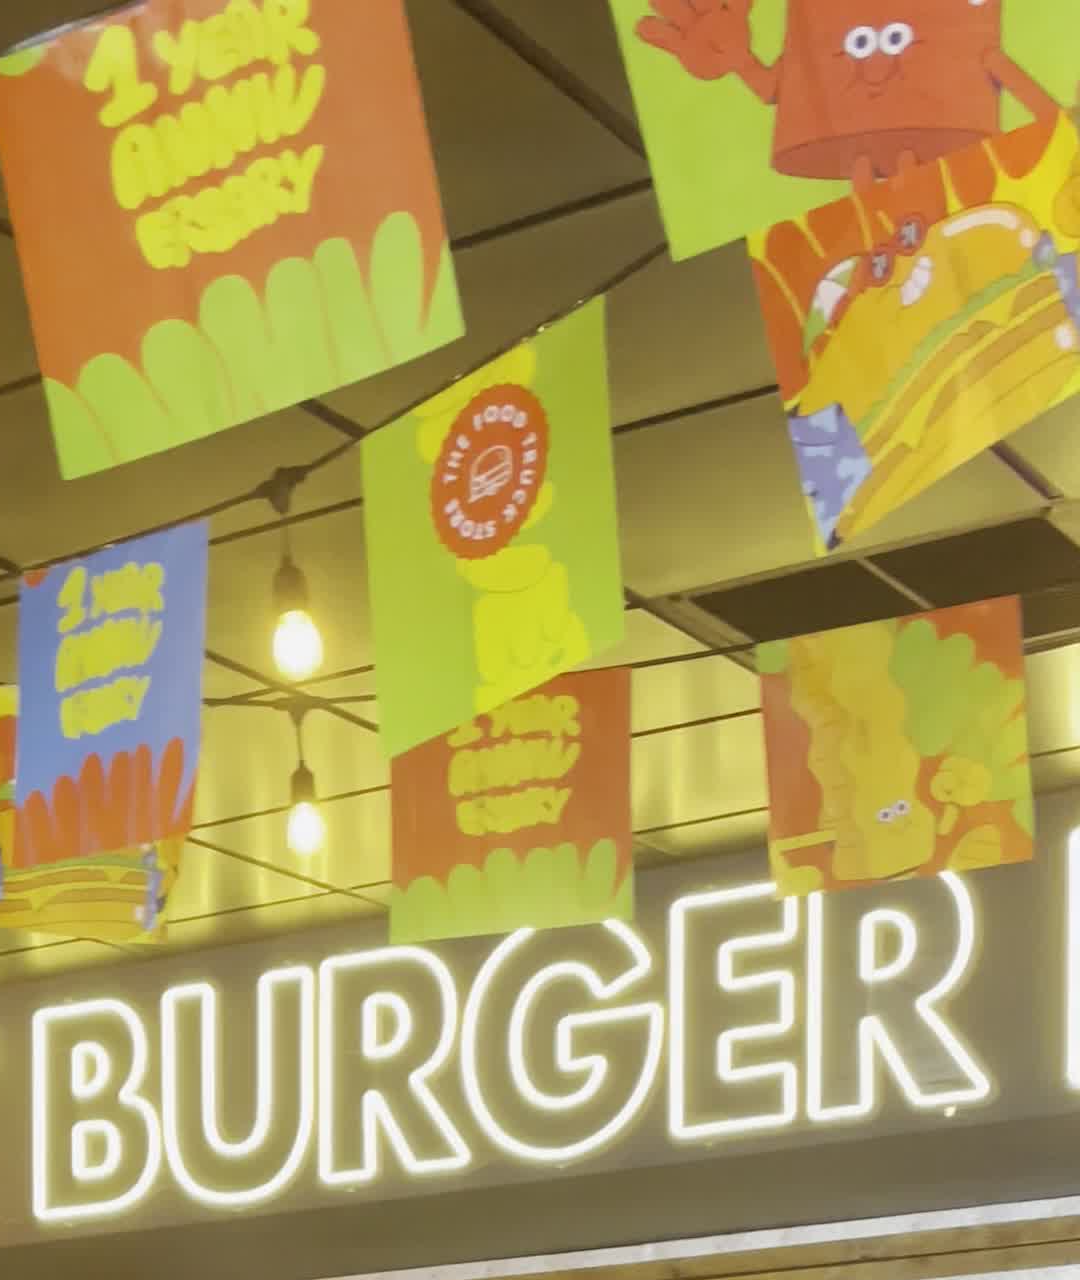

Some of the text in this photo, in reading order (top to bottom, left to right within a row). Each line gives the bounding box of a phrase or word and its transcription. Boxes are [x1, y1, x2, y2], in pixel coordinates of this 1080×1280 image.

[84, 24, 157, 128] 1
[441, 403, 538, 541] THE FOOD TRUCK STORE
[31, 868, 993, 1222] BURGER
